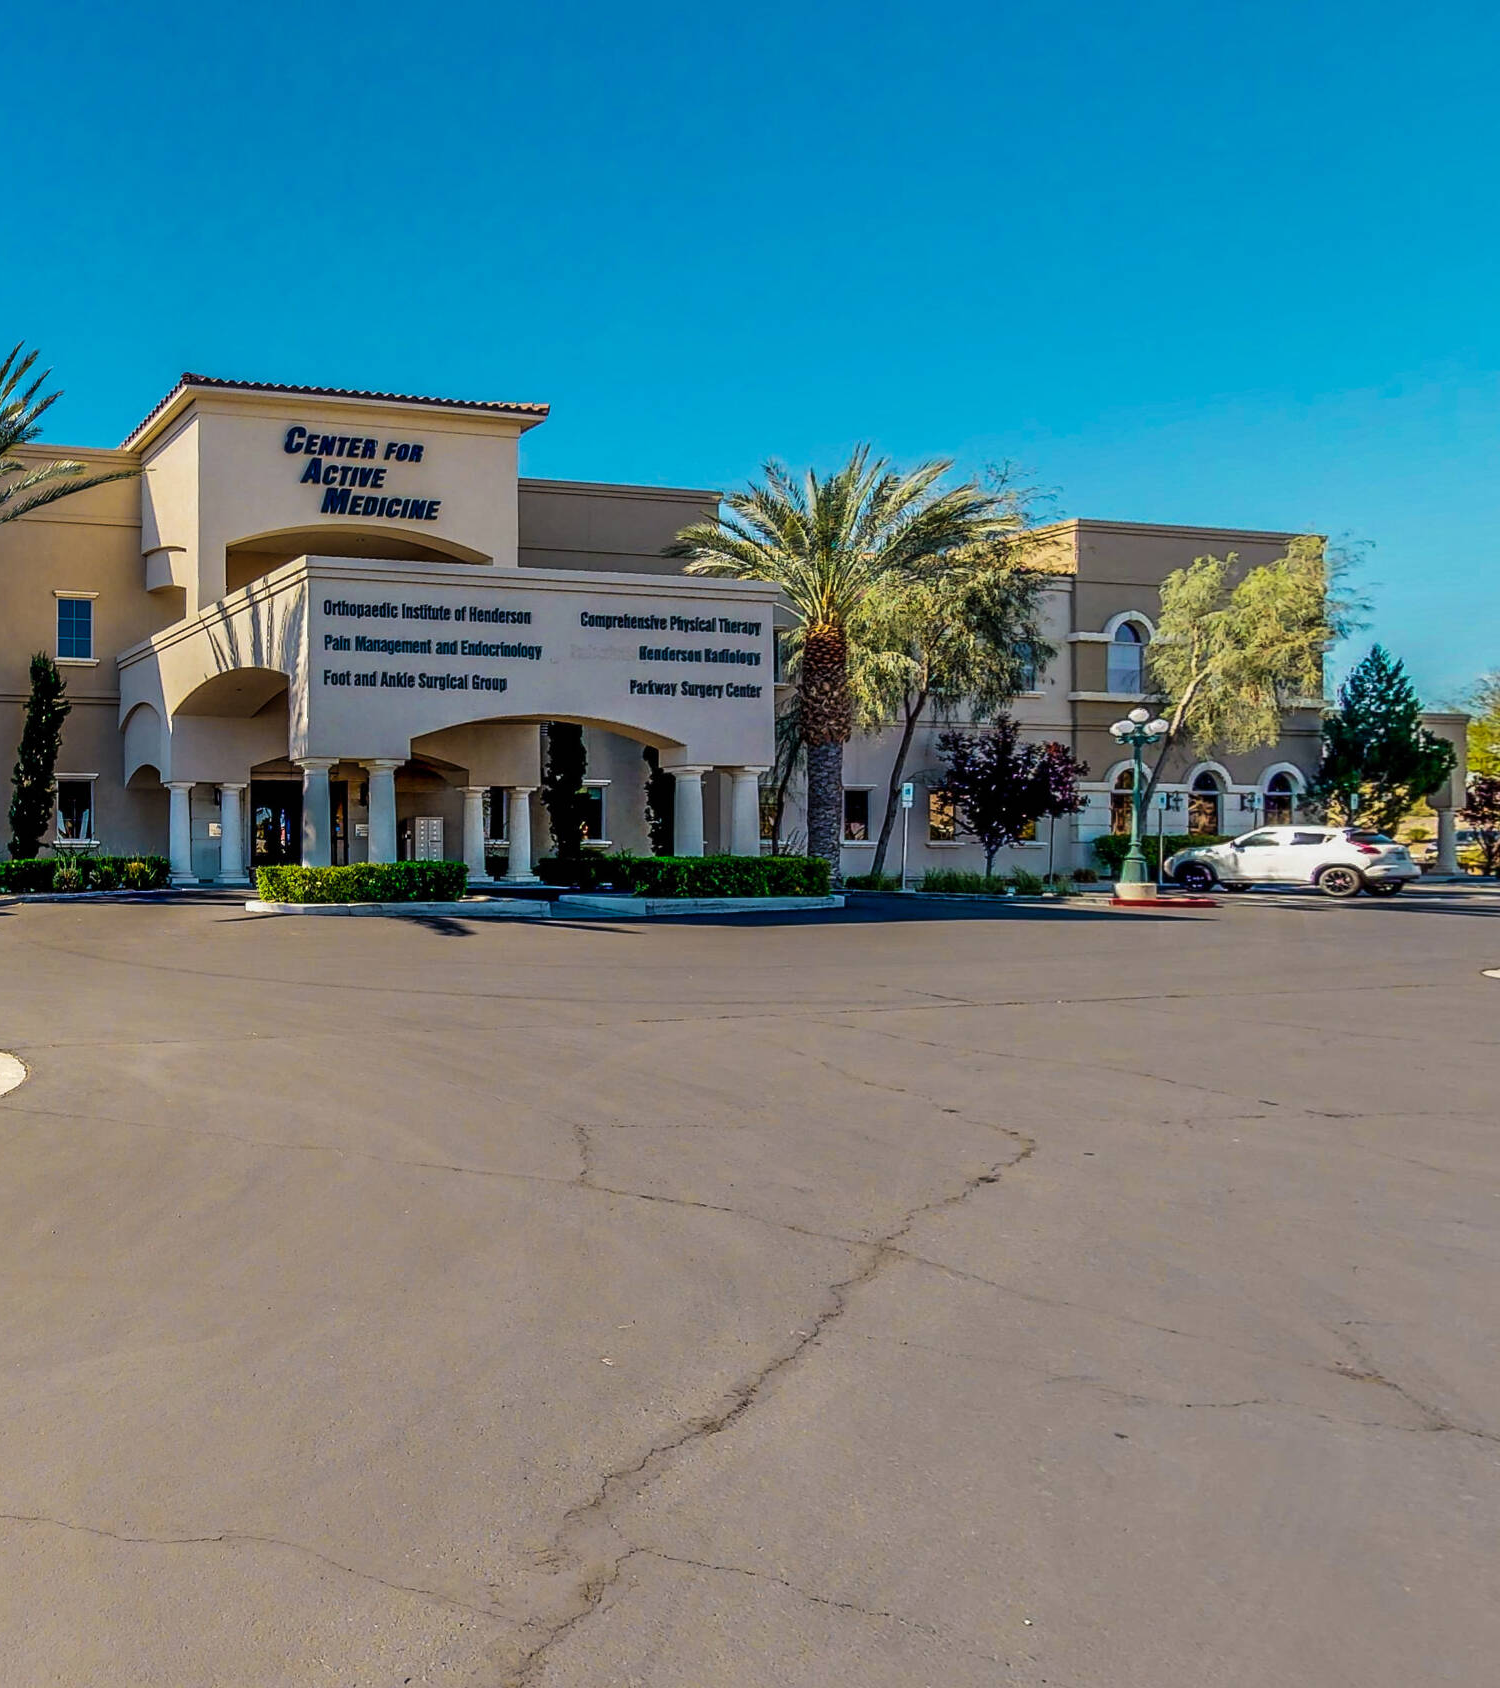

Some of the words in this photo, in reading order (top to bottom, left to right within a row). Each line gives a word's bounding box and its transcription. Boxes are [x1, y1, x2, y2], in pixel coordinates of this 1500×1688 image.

[284, 426, 378, 459] CENTER
[384, 442, 424, 463] FOR
[300, 457, 387, 489] ACTIVE
[320, 487, 441, 521] MEDICINE
[323, 600, 398, 619] Orthopaedic
[401, 603, 450, 621] Institute
[454, 606, 467, 622] of
[469, 607, 532, 625] Henderson
[580, 611, 667, 630] Comprehensive
[670, 615, 716, 633] Physical
[718, 618, 762, 636] Therapy
[324, 634, 350, 651] Pain
[355, 636, 431, 655] Management
[435, 640, 458, 655] and
[461, 640, 542, 660] Endocrinology
[639, 645, 701, 663] Henderson
[704, 648, 761, 666] Radiology
[323, 670, 351, 686] Foot
[354, 671, 377, 687] and
[380, 672, 415, 688] Ankle
[418, 672, 468, 691] Surgical
[472, 674, 507, 693] Group
[629, 679, 678, 697] Parkway
[681, 681, 724, 699] Surgery
[725, 683, 762, 699] Center
